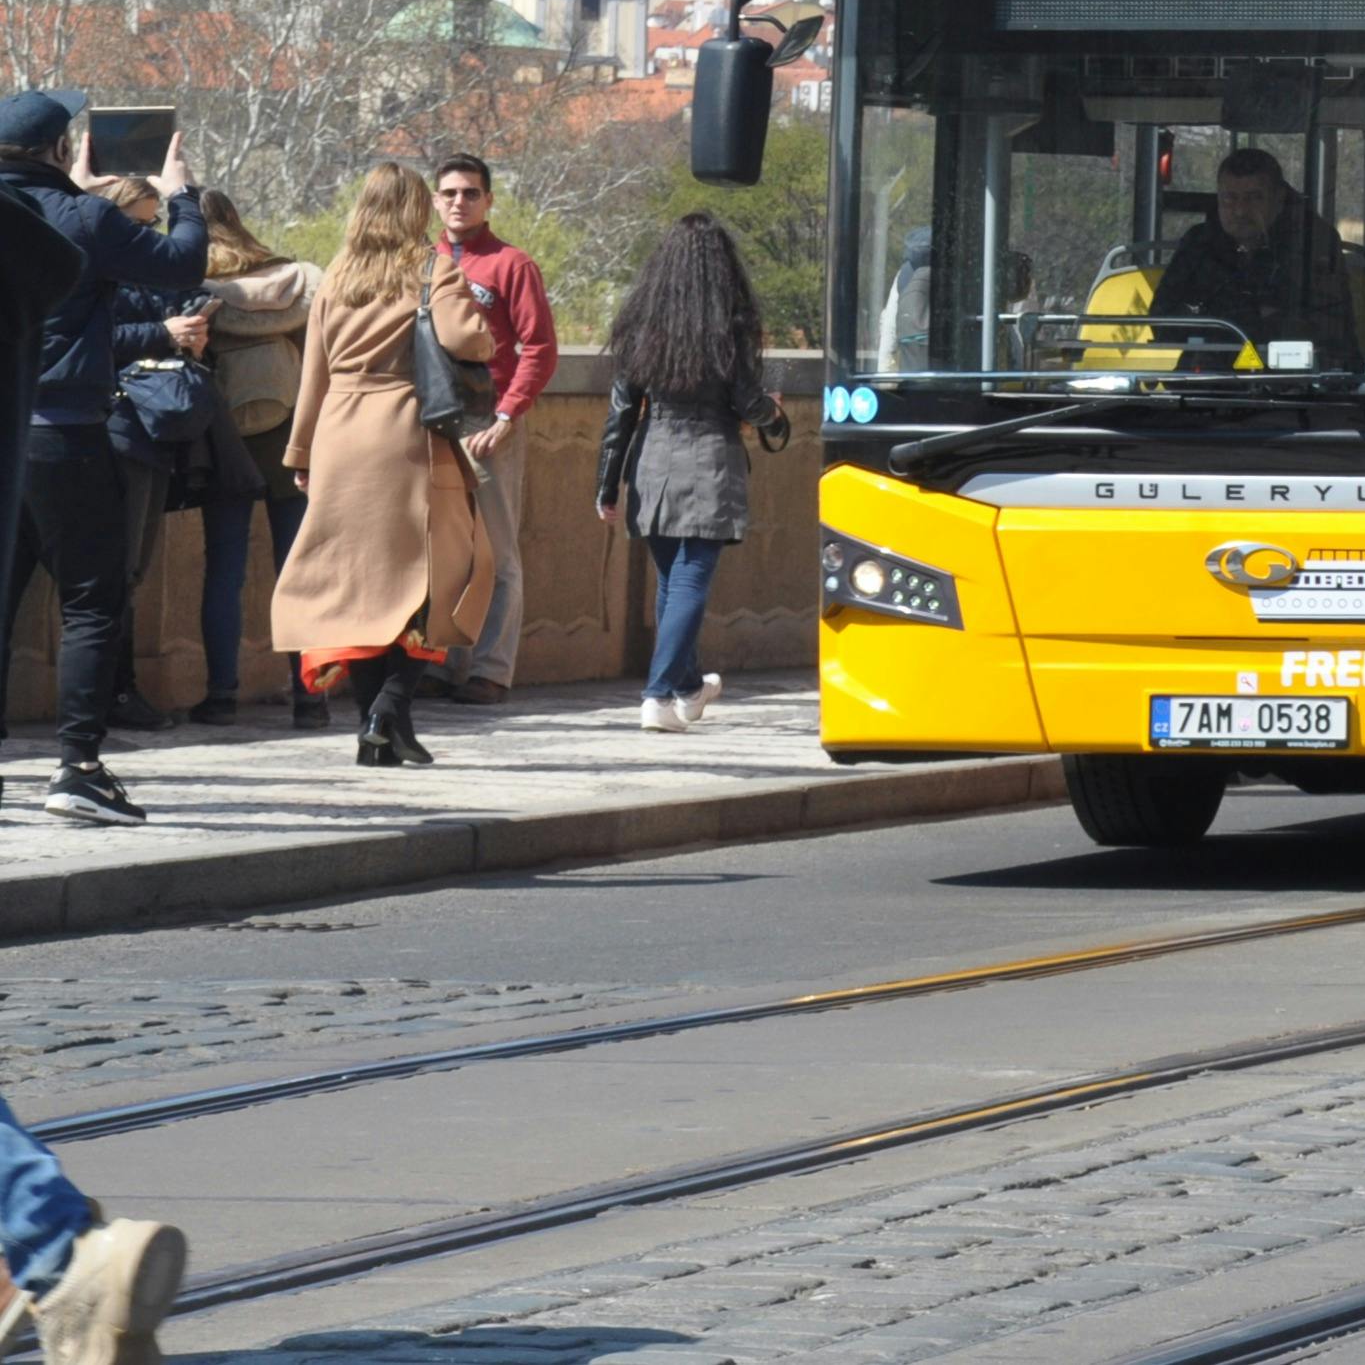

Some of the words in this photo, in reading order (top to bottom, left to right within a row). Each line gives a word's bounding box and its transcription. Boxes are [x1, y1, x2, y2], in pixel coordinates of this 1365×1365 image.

[1153, 722, 1169, 733] CZ
[1178, 702, 1233, 734] 7AM
[1257, 703, 1332, 734] 0538
